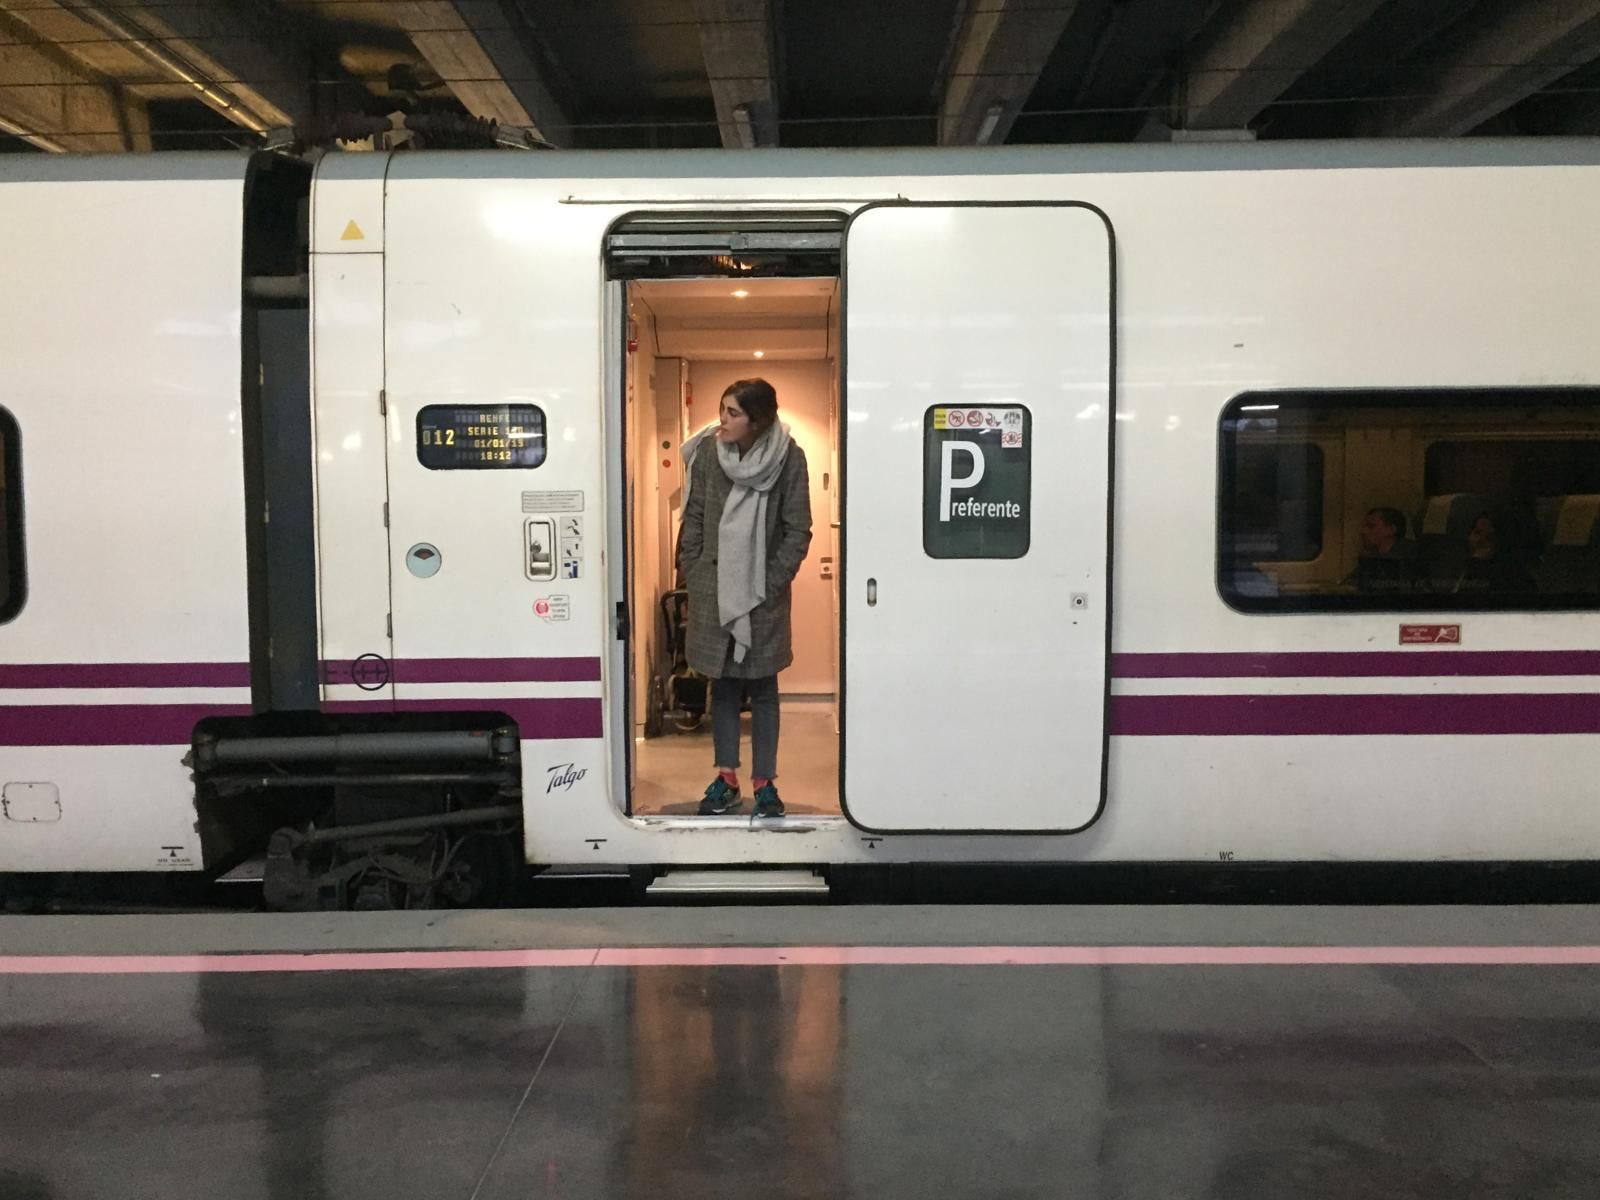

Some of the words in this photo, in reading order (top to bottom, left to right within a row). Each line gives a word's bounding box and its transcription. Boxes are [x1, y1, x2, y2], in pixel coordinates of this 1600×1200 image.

[422, 429, 455, 446] 012
[467, 426, 499, 436] SERIE
[940, 440, 1020, 522] Preferente
[546, 763, 588, 794] Talgo
[1219, 851, 1234, 861] WC
